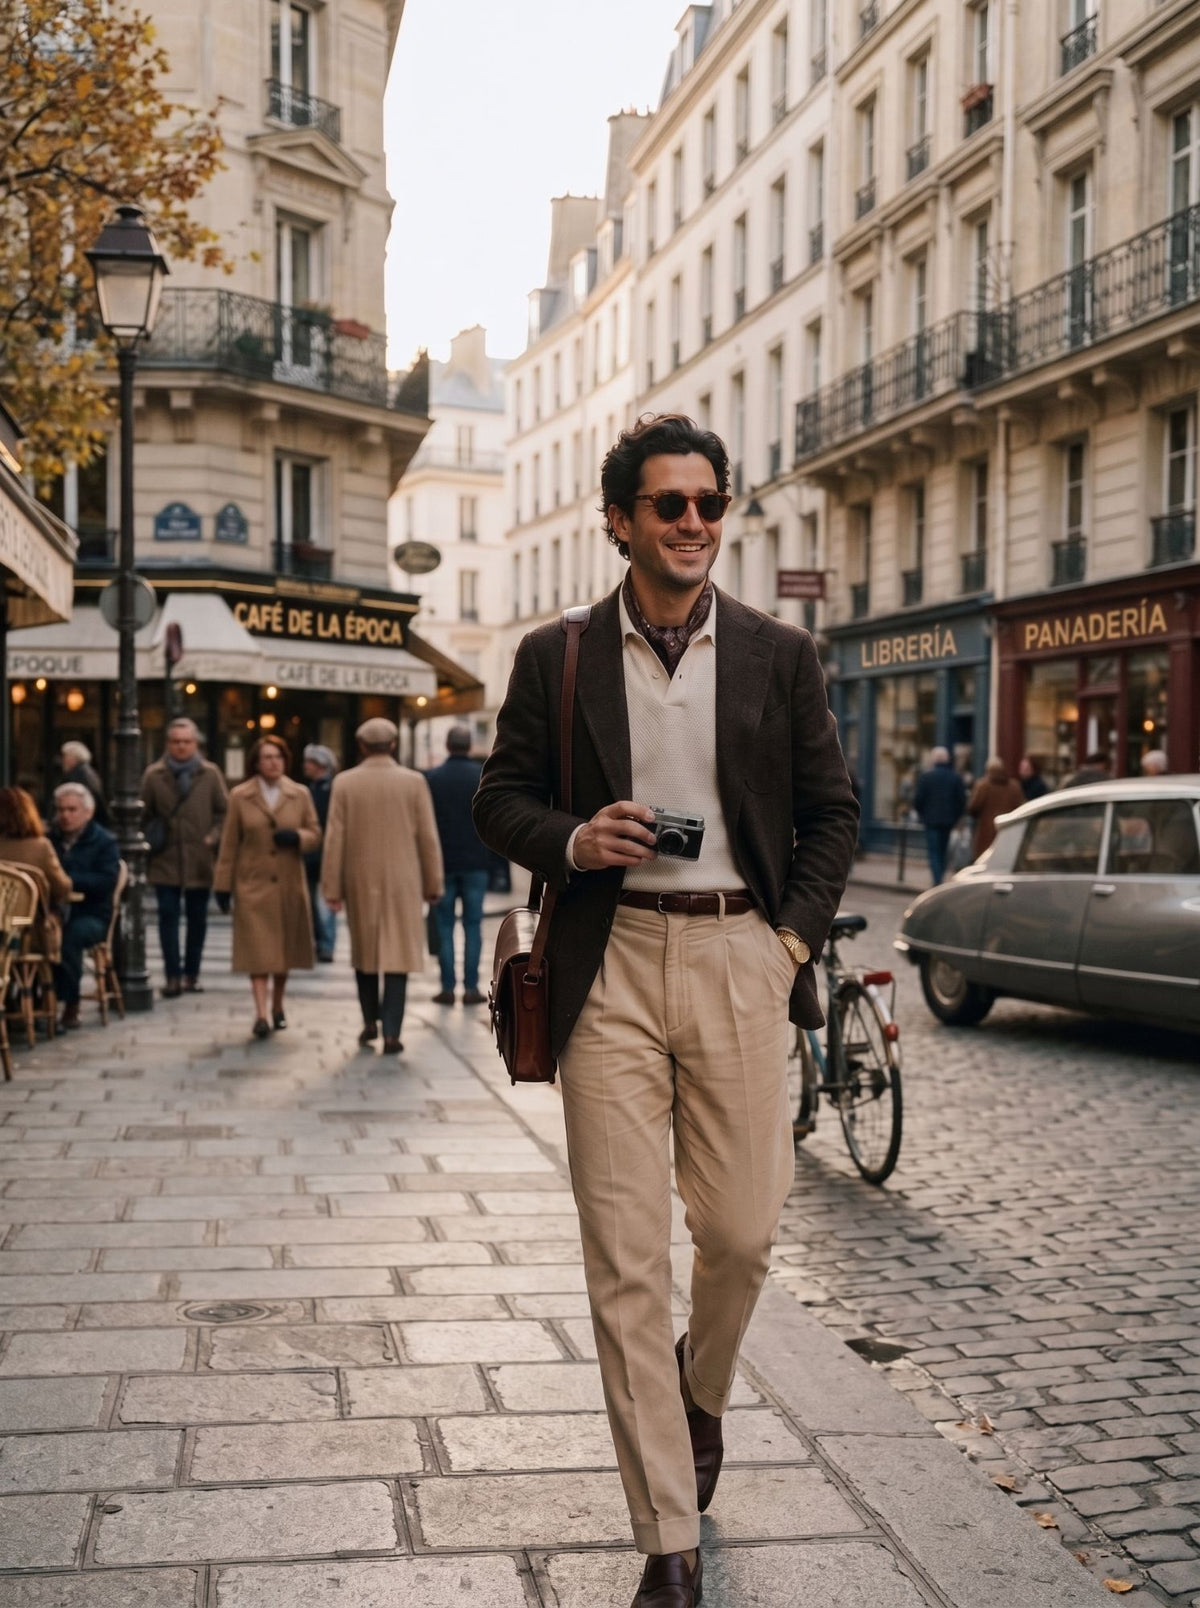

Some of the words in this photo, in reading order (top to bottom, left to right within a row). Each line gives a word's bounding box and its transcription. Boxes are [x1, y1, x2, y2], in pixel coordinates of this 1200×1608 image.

[233, 601, 284, 633] CAFÉ
[288, 609, 313, 636] DE
[317, 612, 341, 638] LA
[345, 610, 403, 645] ÉPOCA
[1025, 598, 1168, 650] PANADERÍA
[861, 624, 957, 668] LIBRERÍA
[276, 661, 314, 686] CAFÉ
[319, 667, 338, 686] DE
[343, 669, 360, 688] LA
[365, 667, 410, 690] ÉPOCA
